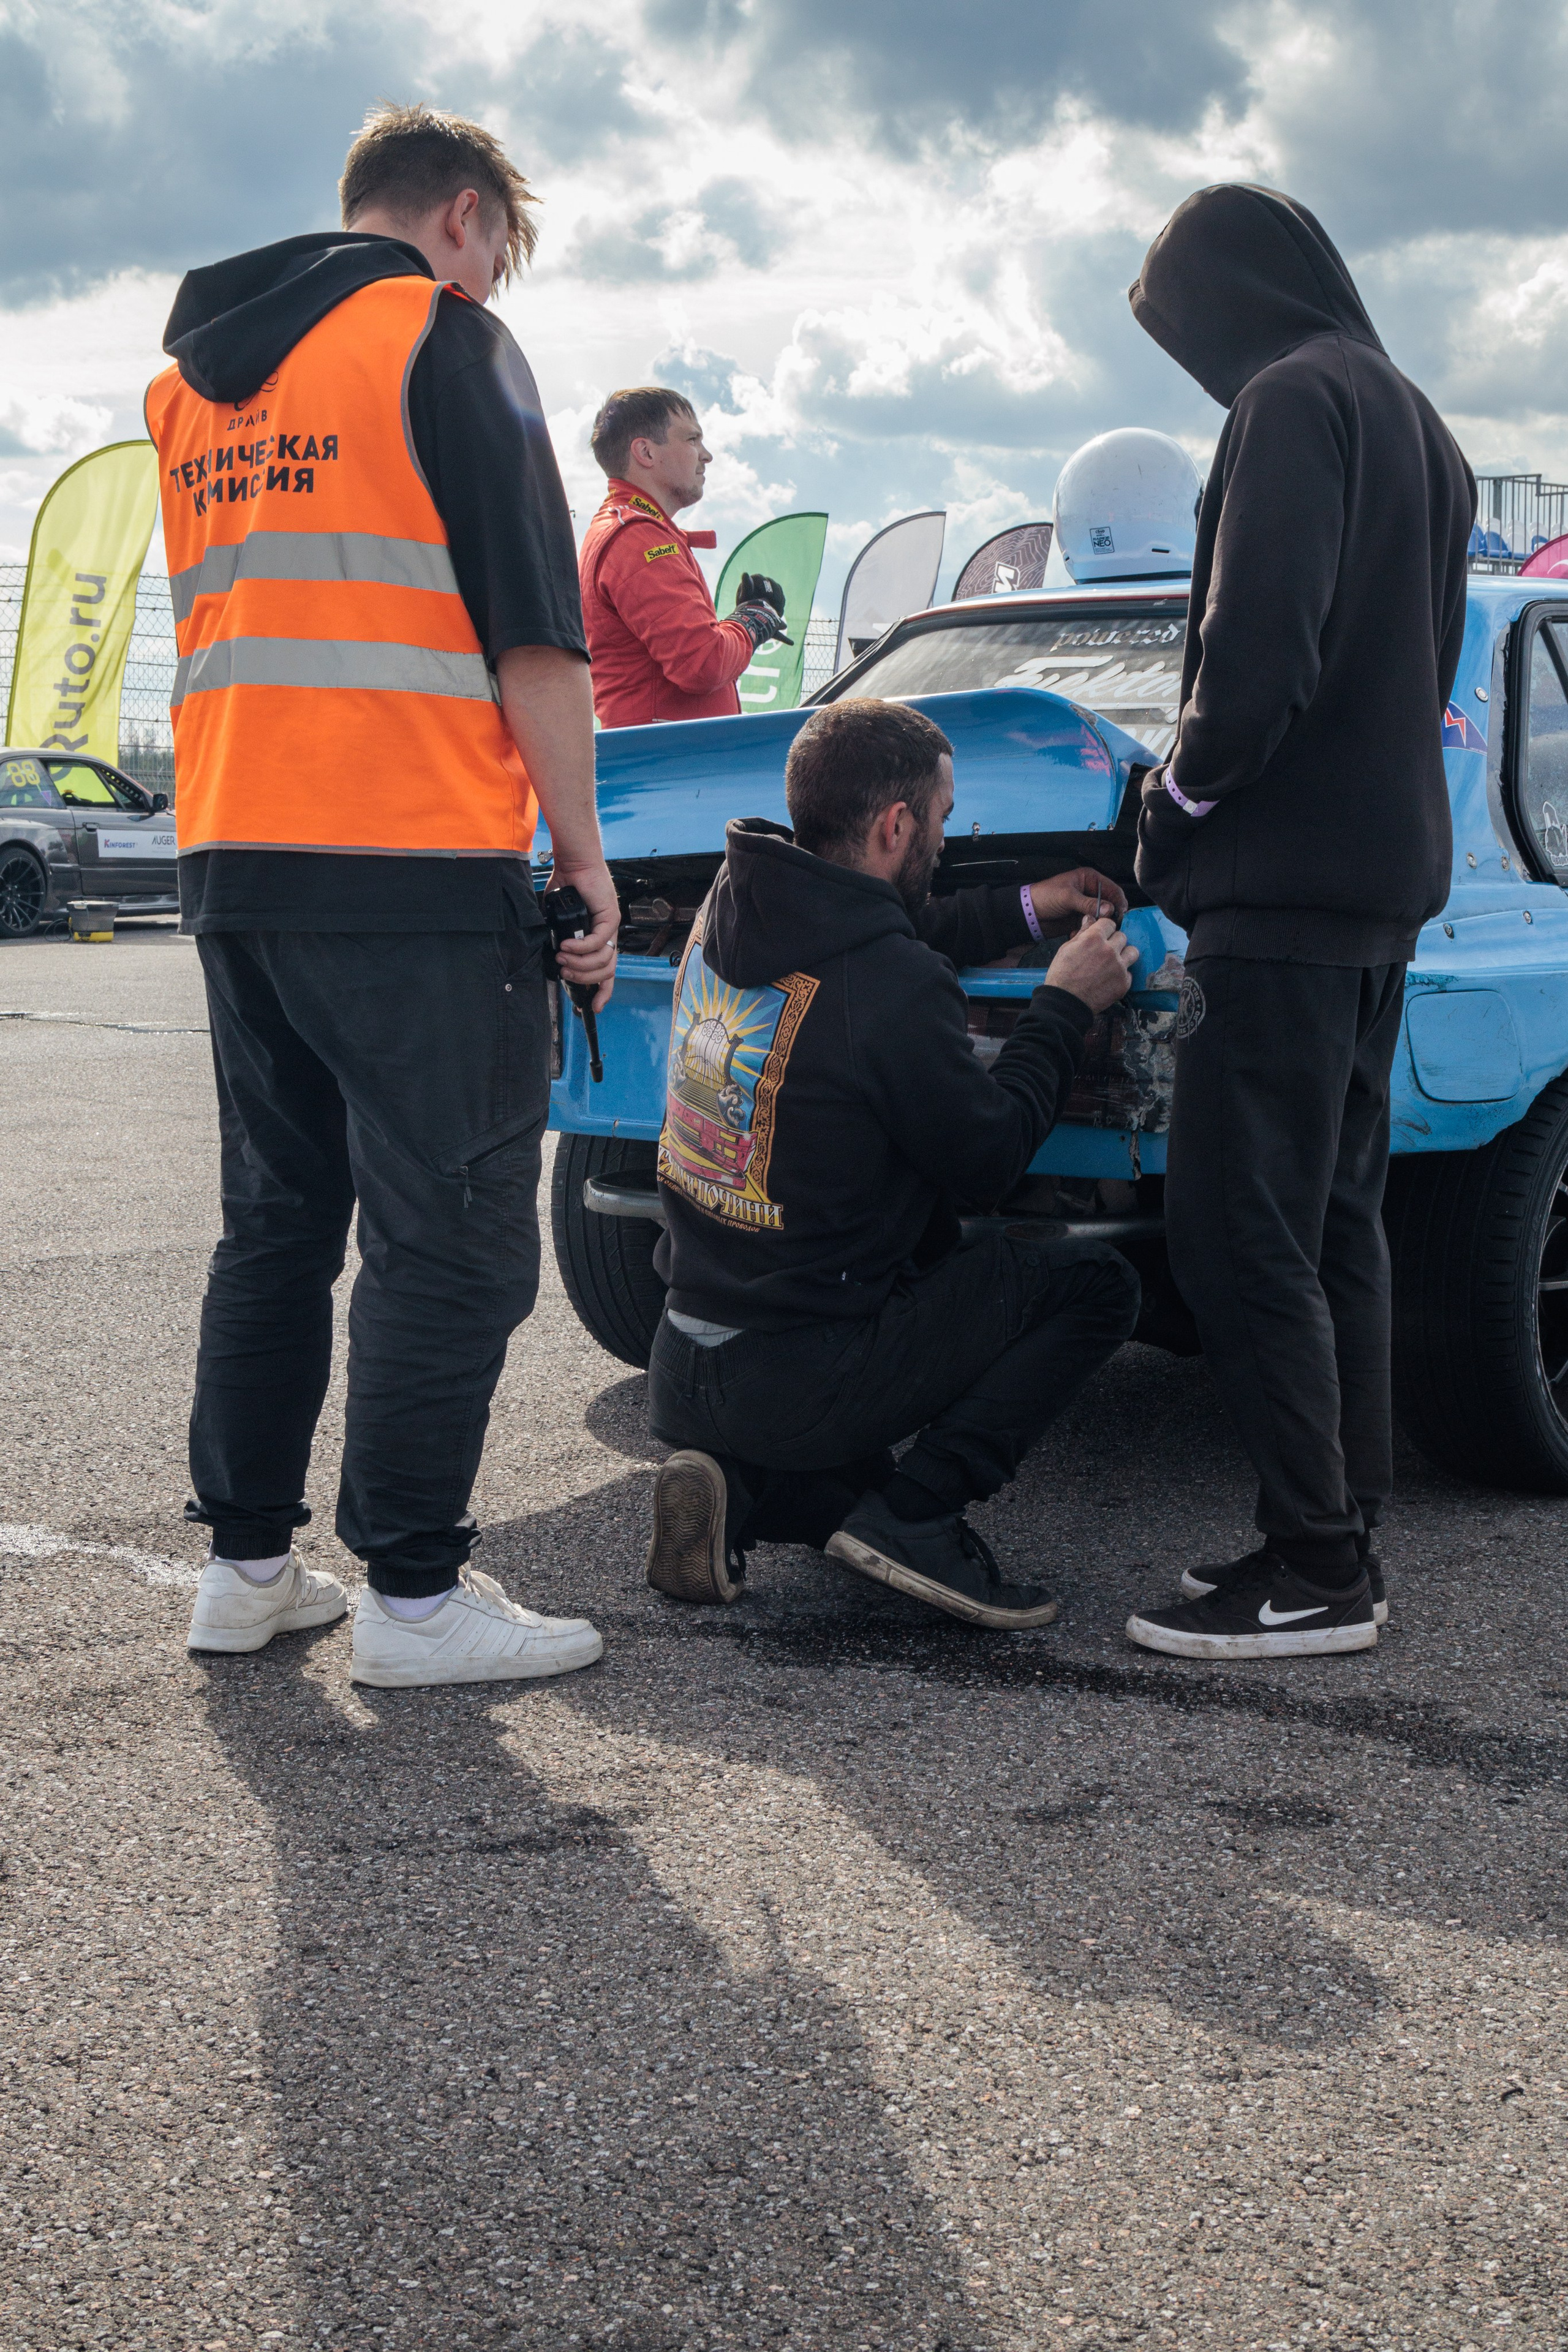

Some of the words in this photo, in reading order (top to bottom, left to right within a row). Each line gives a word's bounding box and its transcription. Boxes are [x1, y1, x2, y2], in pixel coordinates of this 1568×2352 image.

[193, 466, 314, 517] КМИСИЯ
[633, 497, 662, 519] Sabelt
[647, 545, 676, 559] Sabelt
[1050, 623, 1181, 652] powered
[7, 761, 40, 787] 88
[104, 839, 136, 848] KINFOREST
[152, 835, 176, 846] AUGER
[696, 1178, 782, 1227] ПОЧИНИ
[727, 1219, 760, 1232] ПРОВОДОВ
